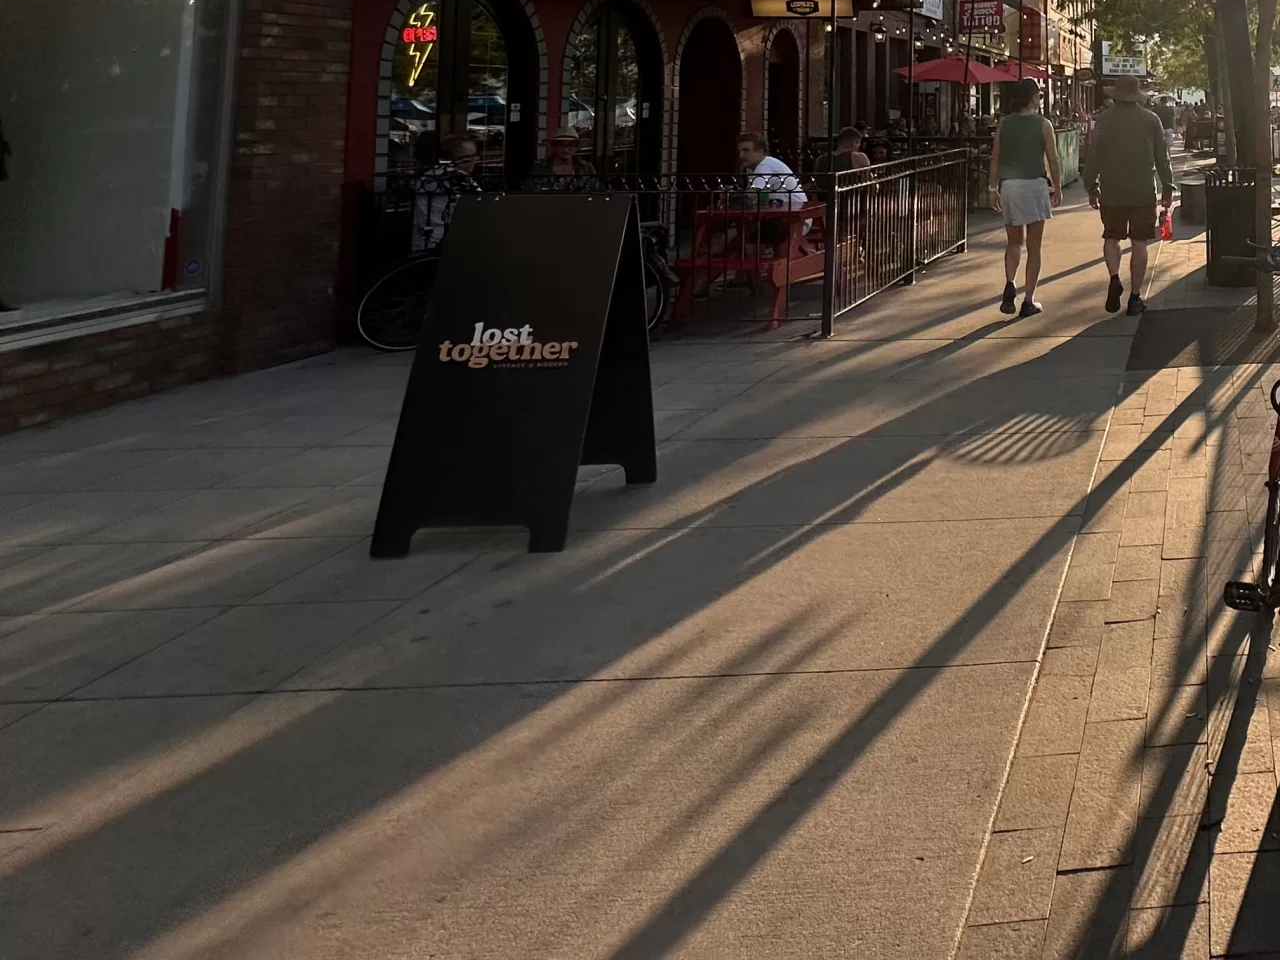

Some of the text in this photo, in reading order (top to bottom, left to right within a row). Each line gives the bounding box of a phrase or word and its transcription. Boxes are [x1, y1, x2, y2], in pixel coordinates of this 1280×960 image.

[403, 26, 437, 43] OPEN
[470, 322, 534, 346] lost
[439, 340, 579, 369] together
